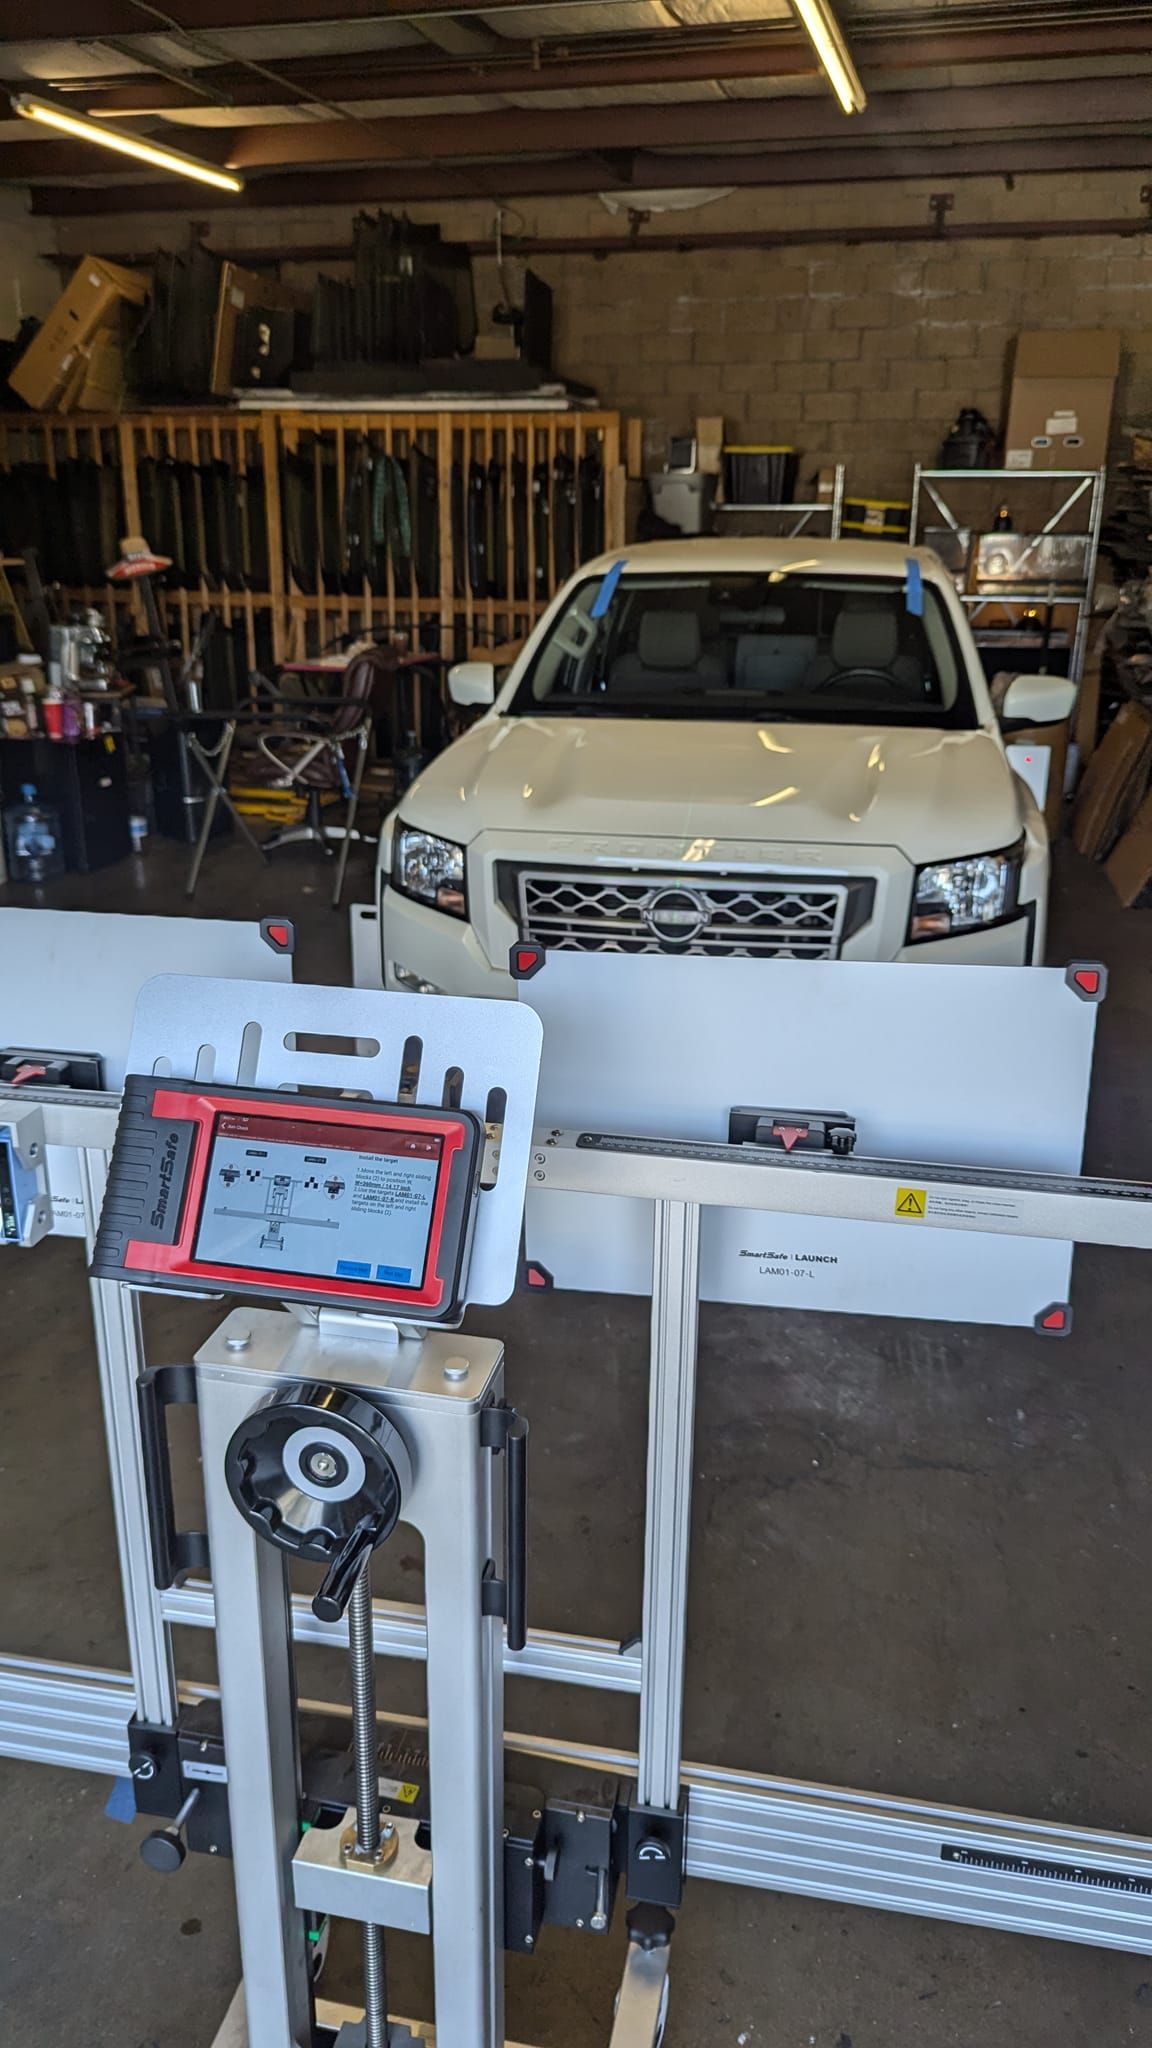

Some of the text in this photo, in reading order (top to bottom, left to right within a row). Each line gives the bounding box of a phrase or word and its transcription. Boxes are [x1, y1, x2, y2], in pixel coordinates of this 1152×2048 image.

[150, 1132, 179, 1230] SmartSafe
[739, 1250, 838, 1264] SmartSafe LAUNCH
[760, 1266, 815, 1278] LAM01-07-L
